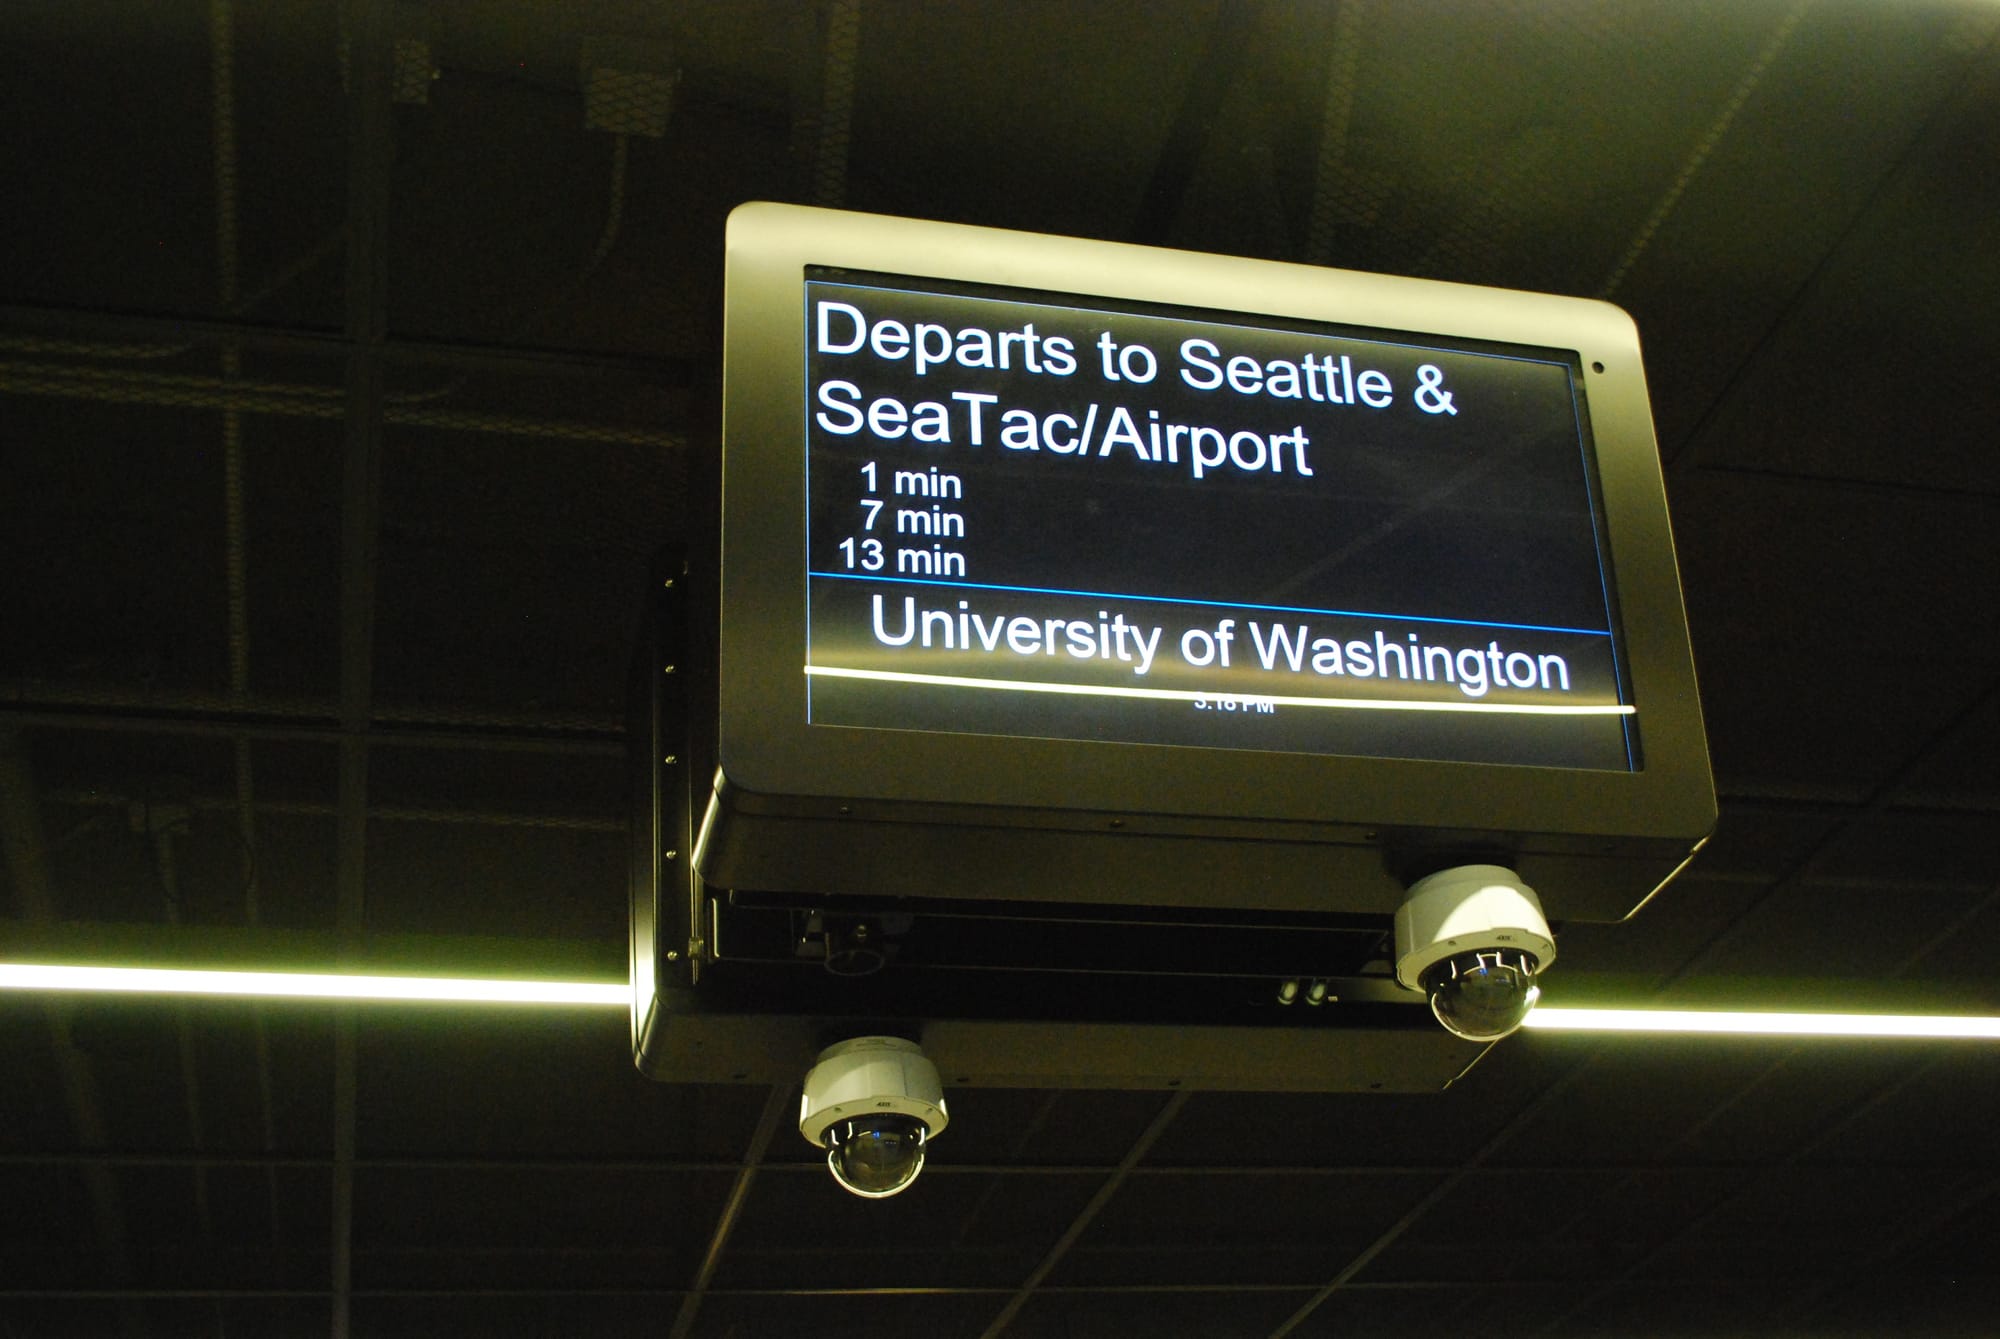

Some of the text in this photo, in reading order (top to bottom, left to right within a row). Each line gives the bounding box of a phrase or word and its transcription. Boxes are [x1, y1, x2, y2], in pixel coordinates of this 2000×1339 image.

[816, 300, 1458, 417] Departs to Seattle &
[816, 380, 1313, 480] SeaTac/Airport
[861, 461, 962, 499] 1 min
[861, 499, 965, 537] 7 min
[839, 537, 966, 578] 13 min
[871, 594, 1570, 698] University of Washington
[1242, 694, 1275, 714] PM
